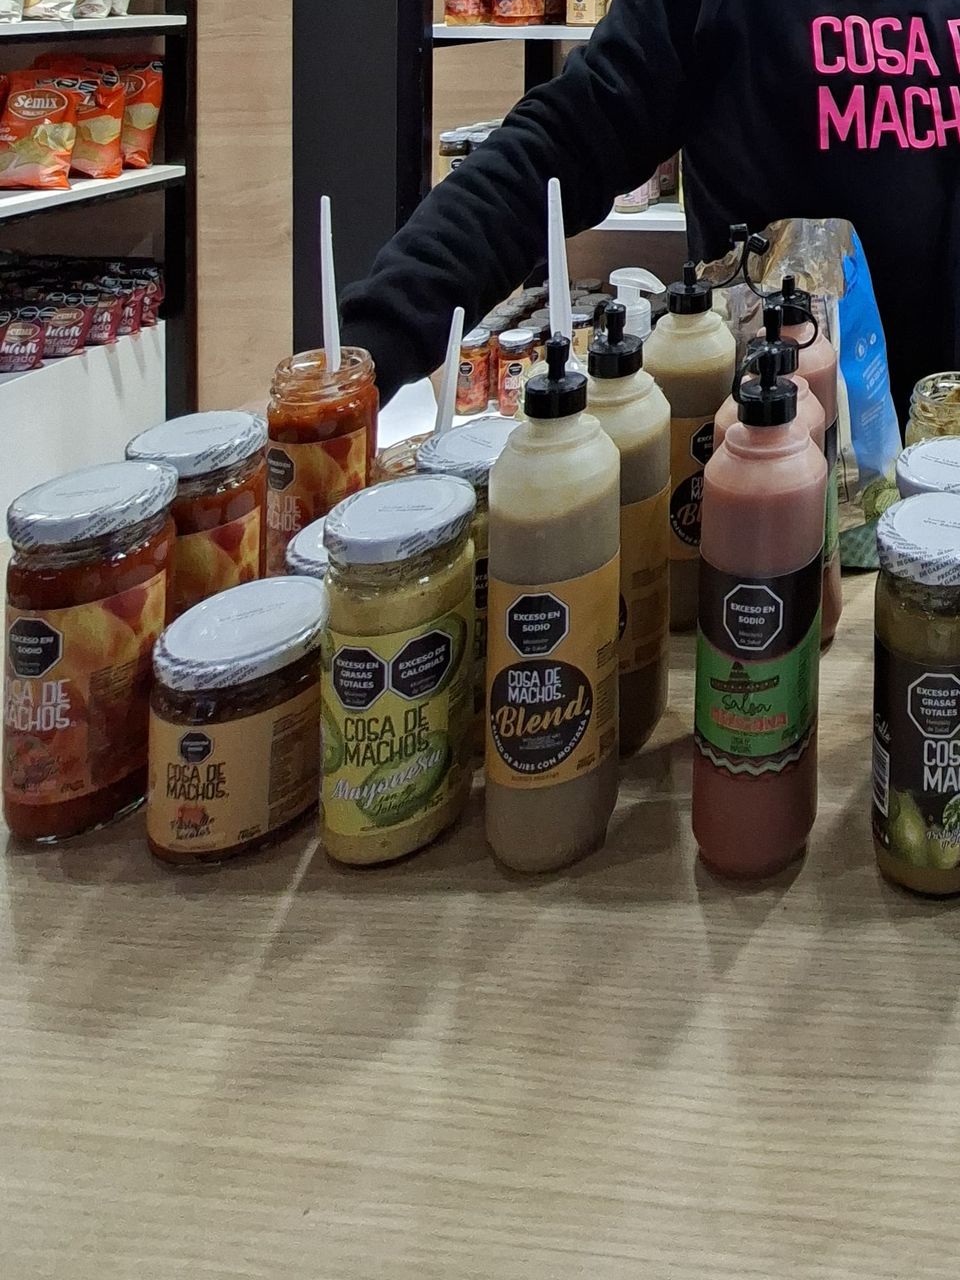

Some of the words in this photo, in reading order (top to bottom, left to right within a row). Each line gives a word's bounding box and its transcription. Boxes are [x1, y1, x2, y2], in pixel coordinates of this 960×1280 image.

[811, 14, 942, 76] COSA
[729, 602, 762, 613] EXCESO
[762, 605, 776, 613] EN
[513, 612, 546, 621] EXCESO
[547, 610, 561, 620] EN
[738, 616, 765, 625] SODIO
[522, 623, 551, 632] SODIO
[399, 649, 434, 671] EXCESO
[434, 643, 447, 656] DE
[336, 658, 365, 669] EXCESO
[366, 660, 379, 670] EN
[400, 654, 445, 679] CALORIAS
[341, 669, 373, 679] GRASAS
[508, 669, 541, 688] COSA
[545, 667, 562, 686] DE
[339, 678, 374, 689] TOTALES
[42, 678, 71, 705] DE
[916, 686, 950, 697] EXCESO
[922, 698, 957, 707] GRASAS
[496, 684, 589, 738] Blend
[920, 707, 958, 717] TOTALES
[344, 715, 396, 742] COSA
[403, 702, 430, 733] DE
[537, 757, 557, 770] CON
[167, 762, 200, 784] COSA
[206, 761, 226, 782] DE
